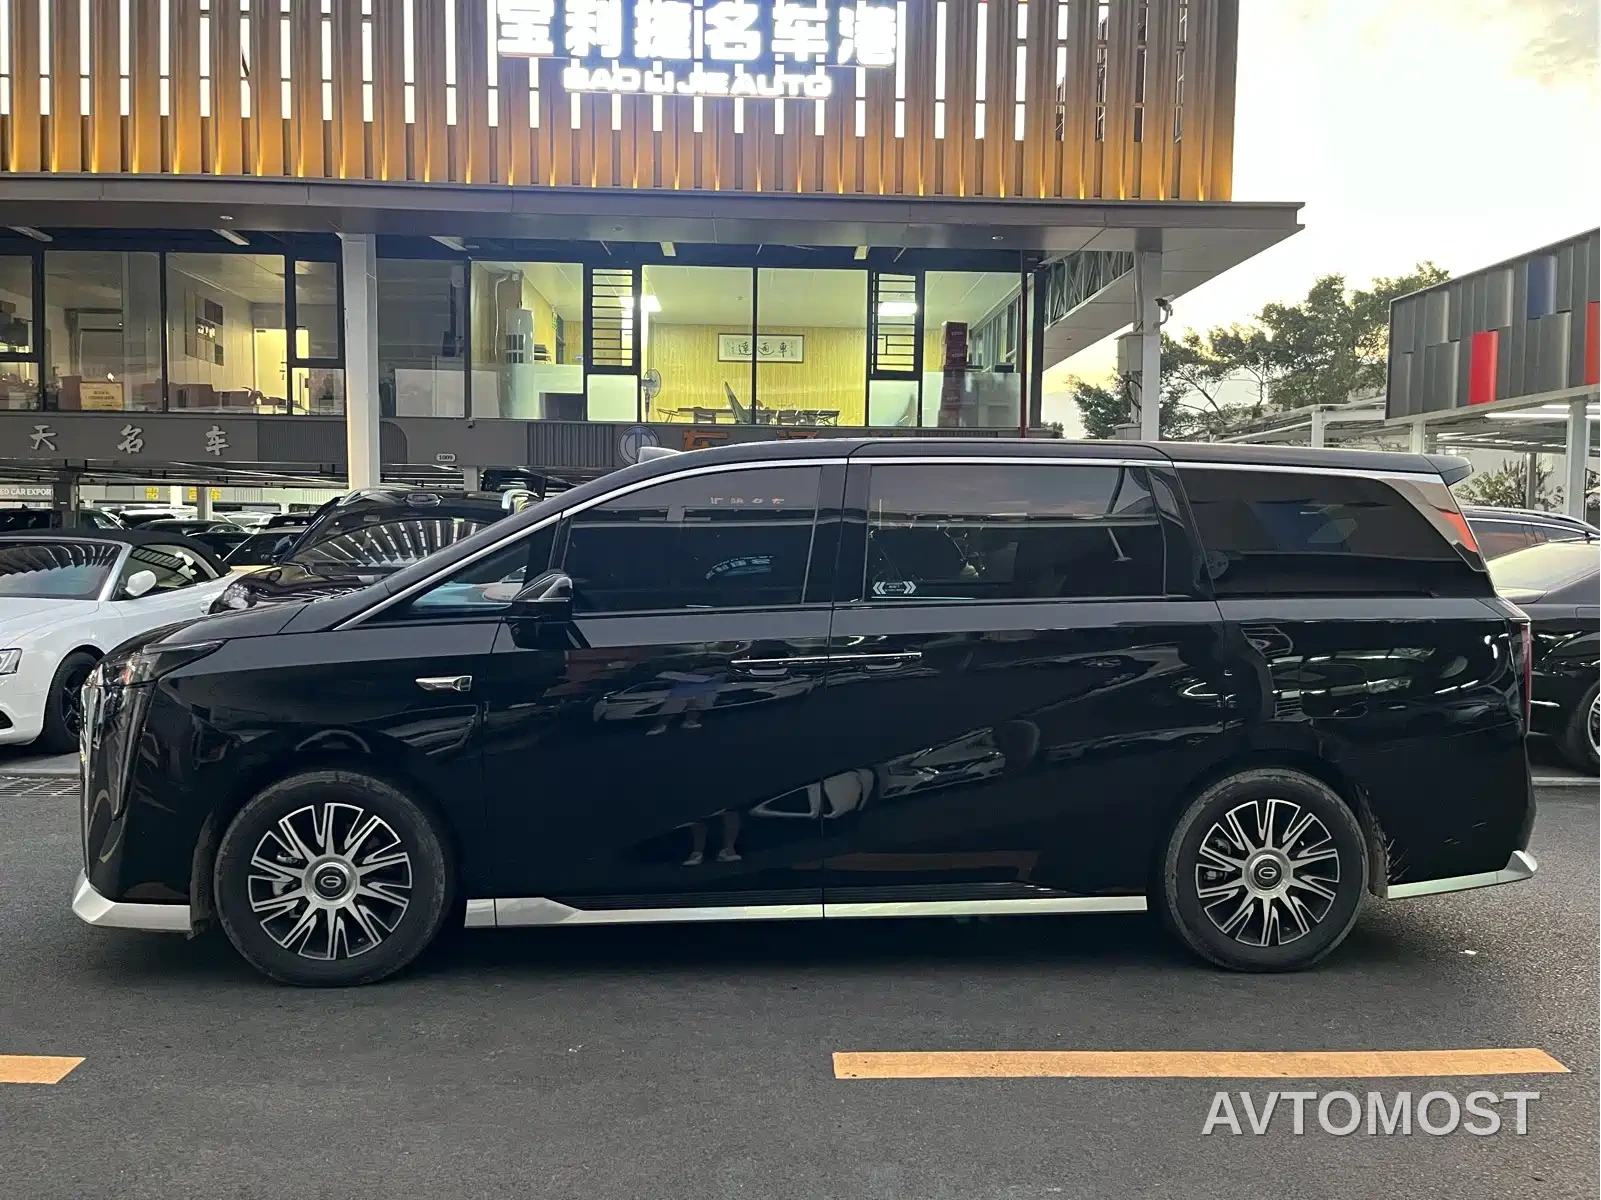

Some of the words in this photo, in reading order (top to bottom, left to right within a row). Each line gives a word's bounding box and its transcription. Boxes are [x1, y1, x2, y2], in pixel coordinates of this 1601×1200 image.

[563, 67, 640, 91] BAO
[730, 73, 833, 97] AUTO
[10, 488, 27, 496] CAR
[27, 488, 53, 496] EXPOR
